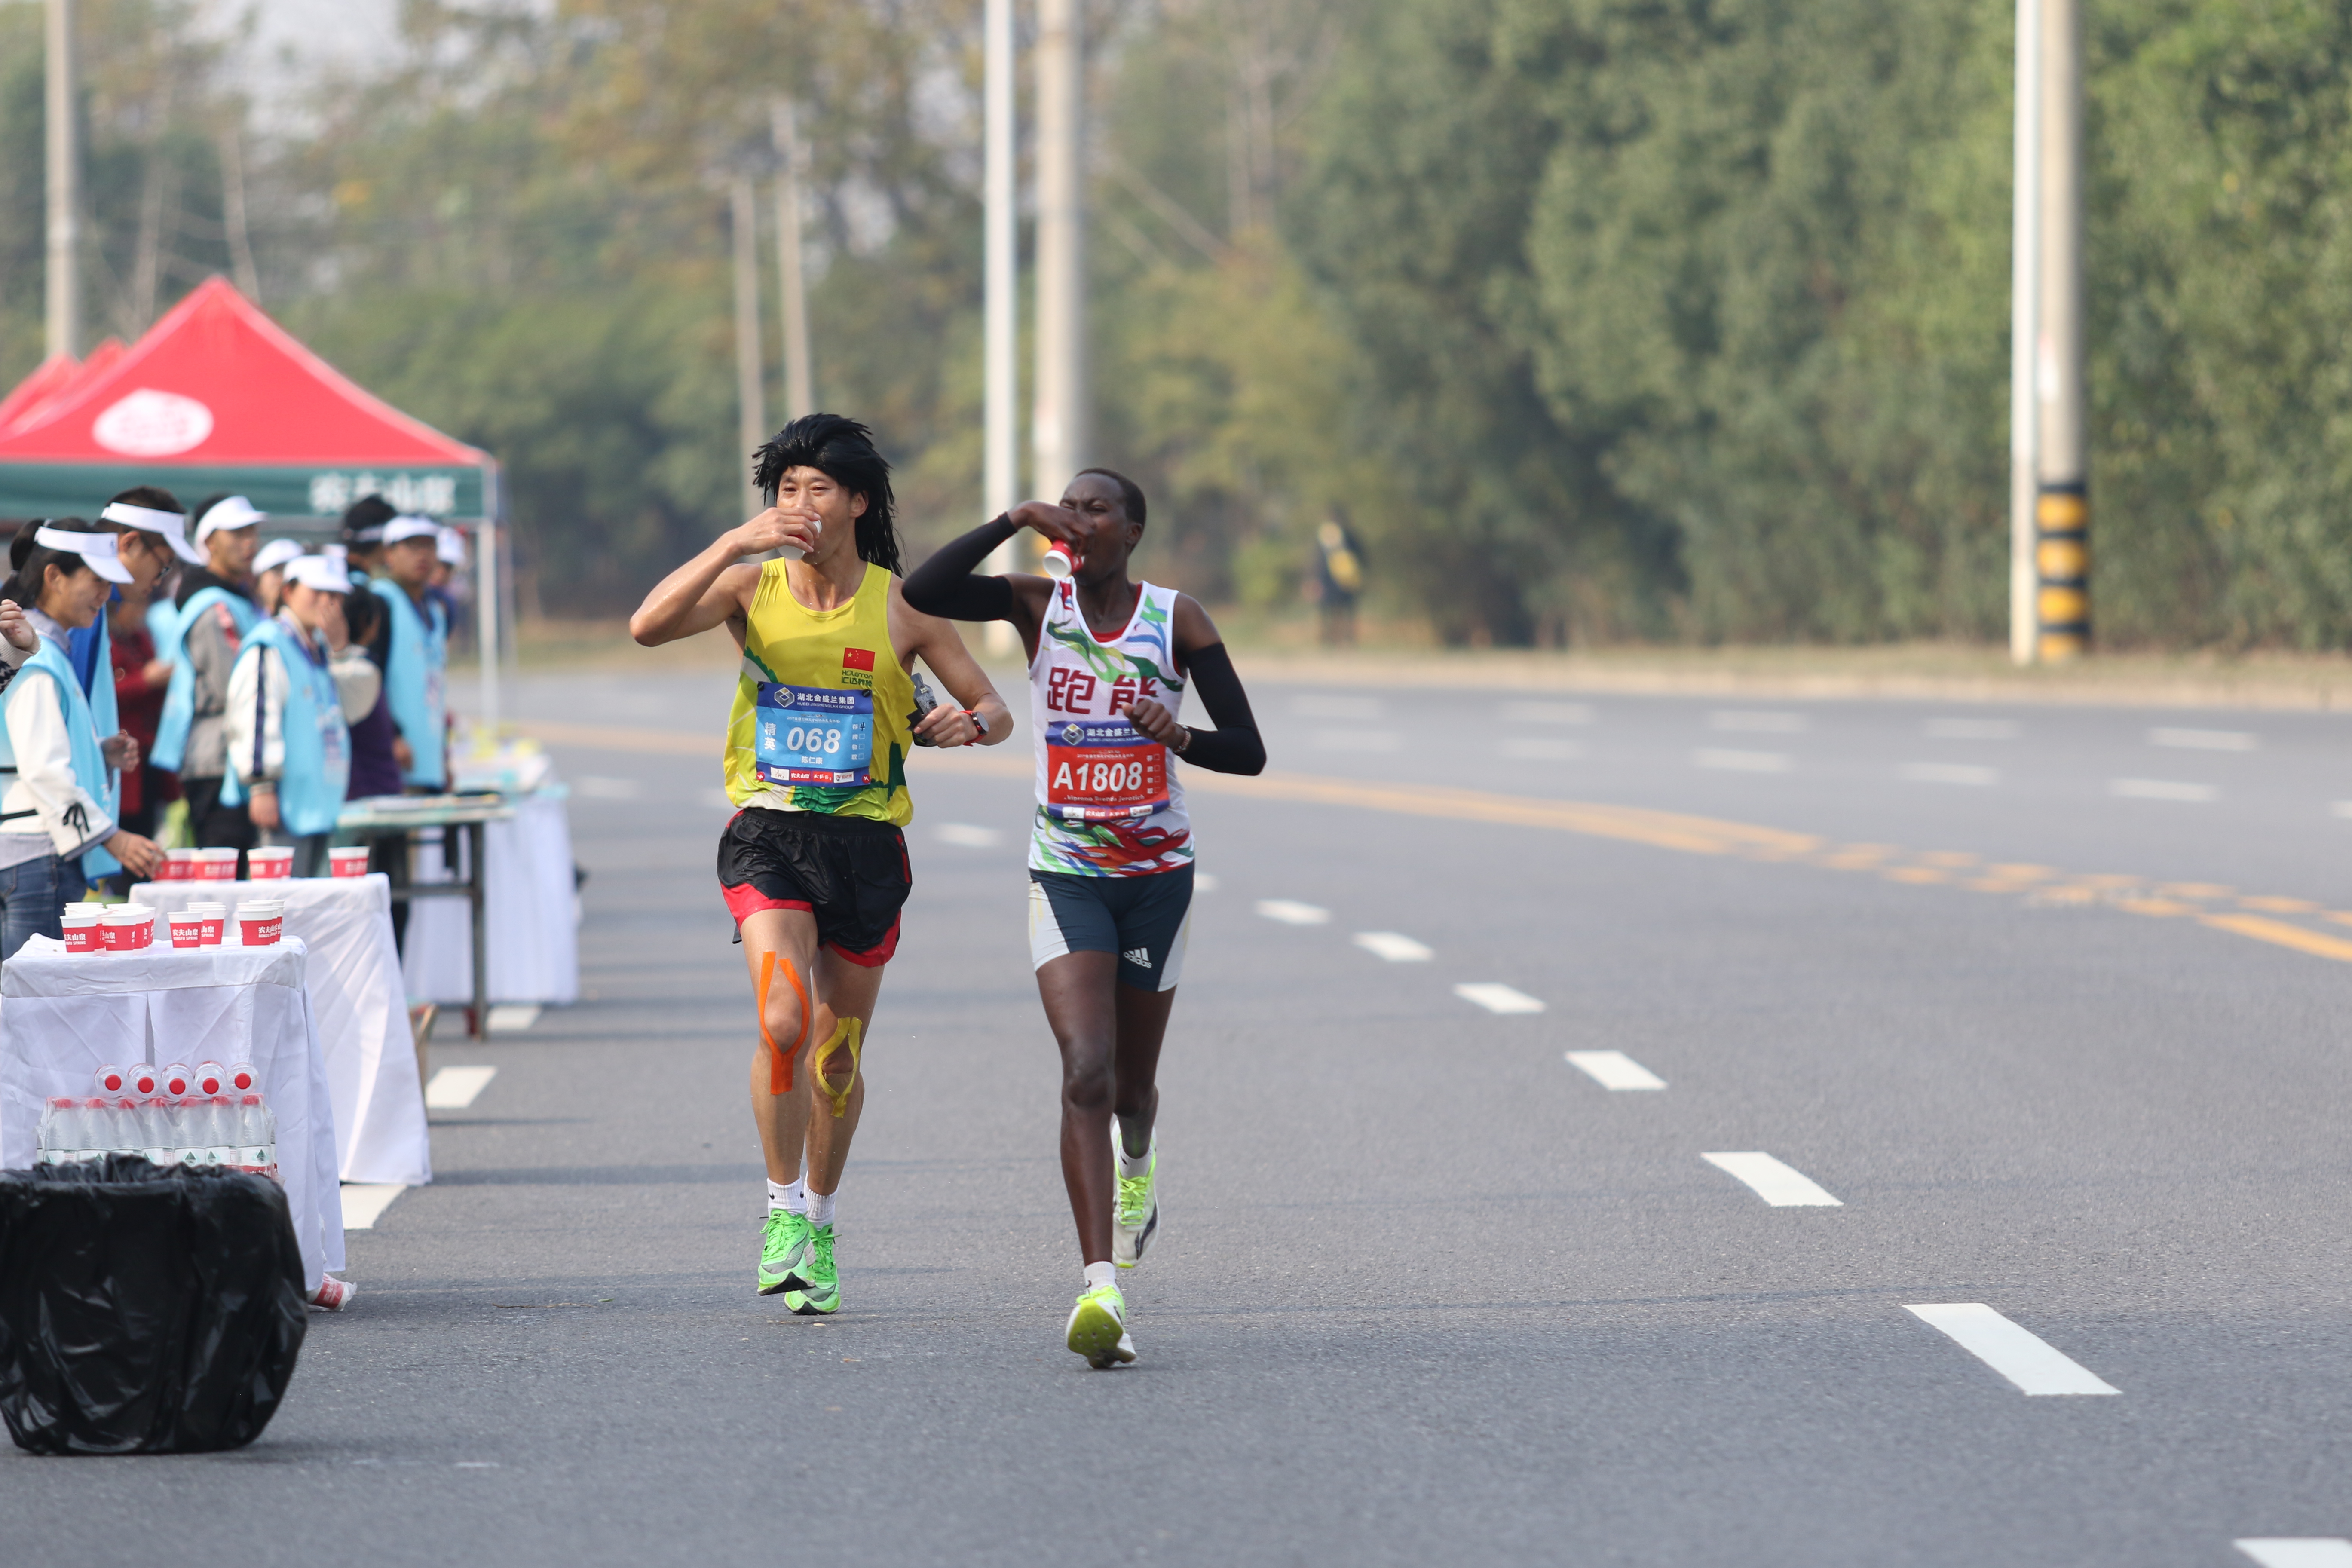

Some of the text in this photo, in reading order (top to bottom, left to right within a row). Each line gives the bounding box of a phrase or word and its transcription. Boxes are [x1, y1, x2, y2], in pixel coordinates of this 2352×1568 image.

[797, 692, 854, 704] 湖北金盛兰集团
[1047, 667, 1157, 715] 跑能
[764, 722, 776, 751] 精英
[860, 722, 865, 731] 4
[787, 727, 841, 753] 068
[801, 756, 823, 765] 陈仁康
[1053, 762, 1143, 792] A1808
[1124, 952, 1152, 968] adidas
